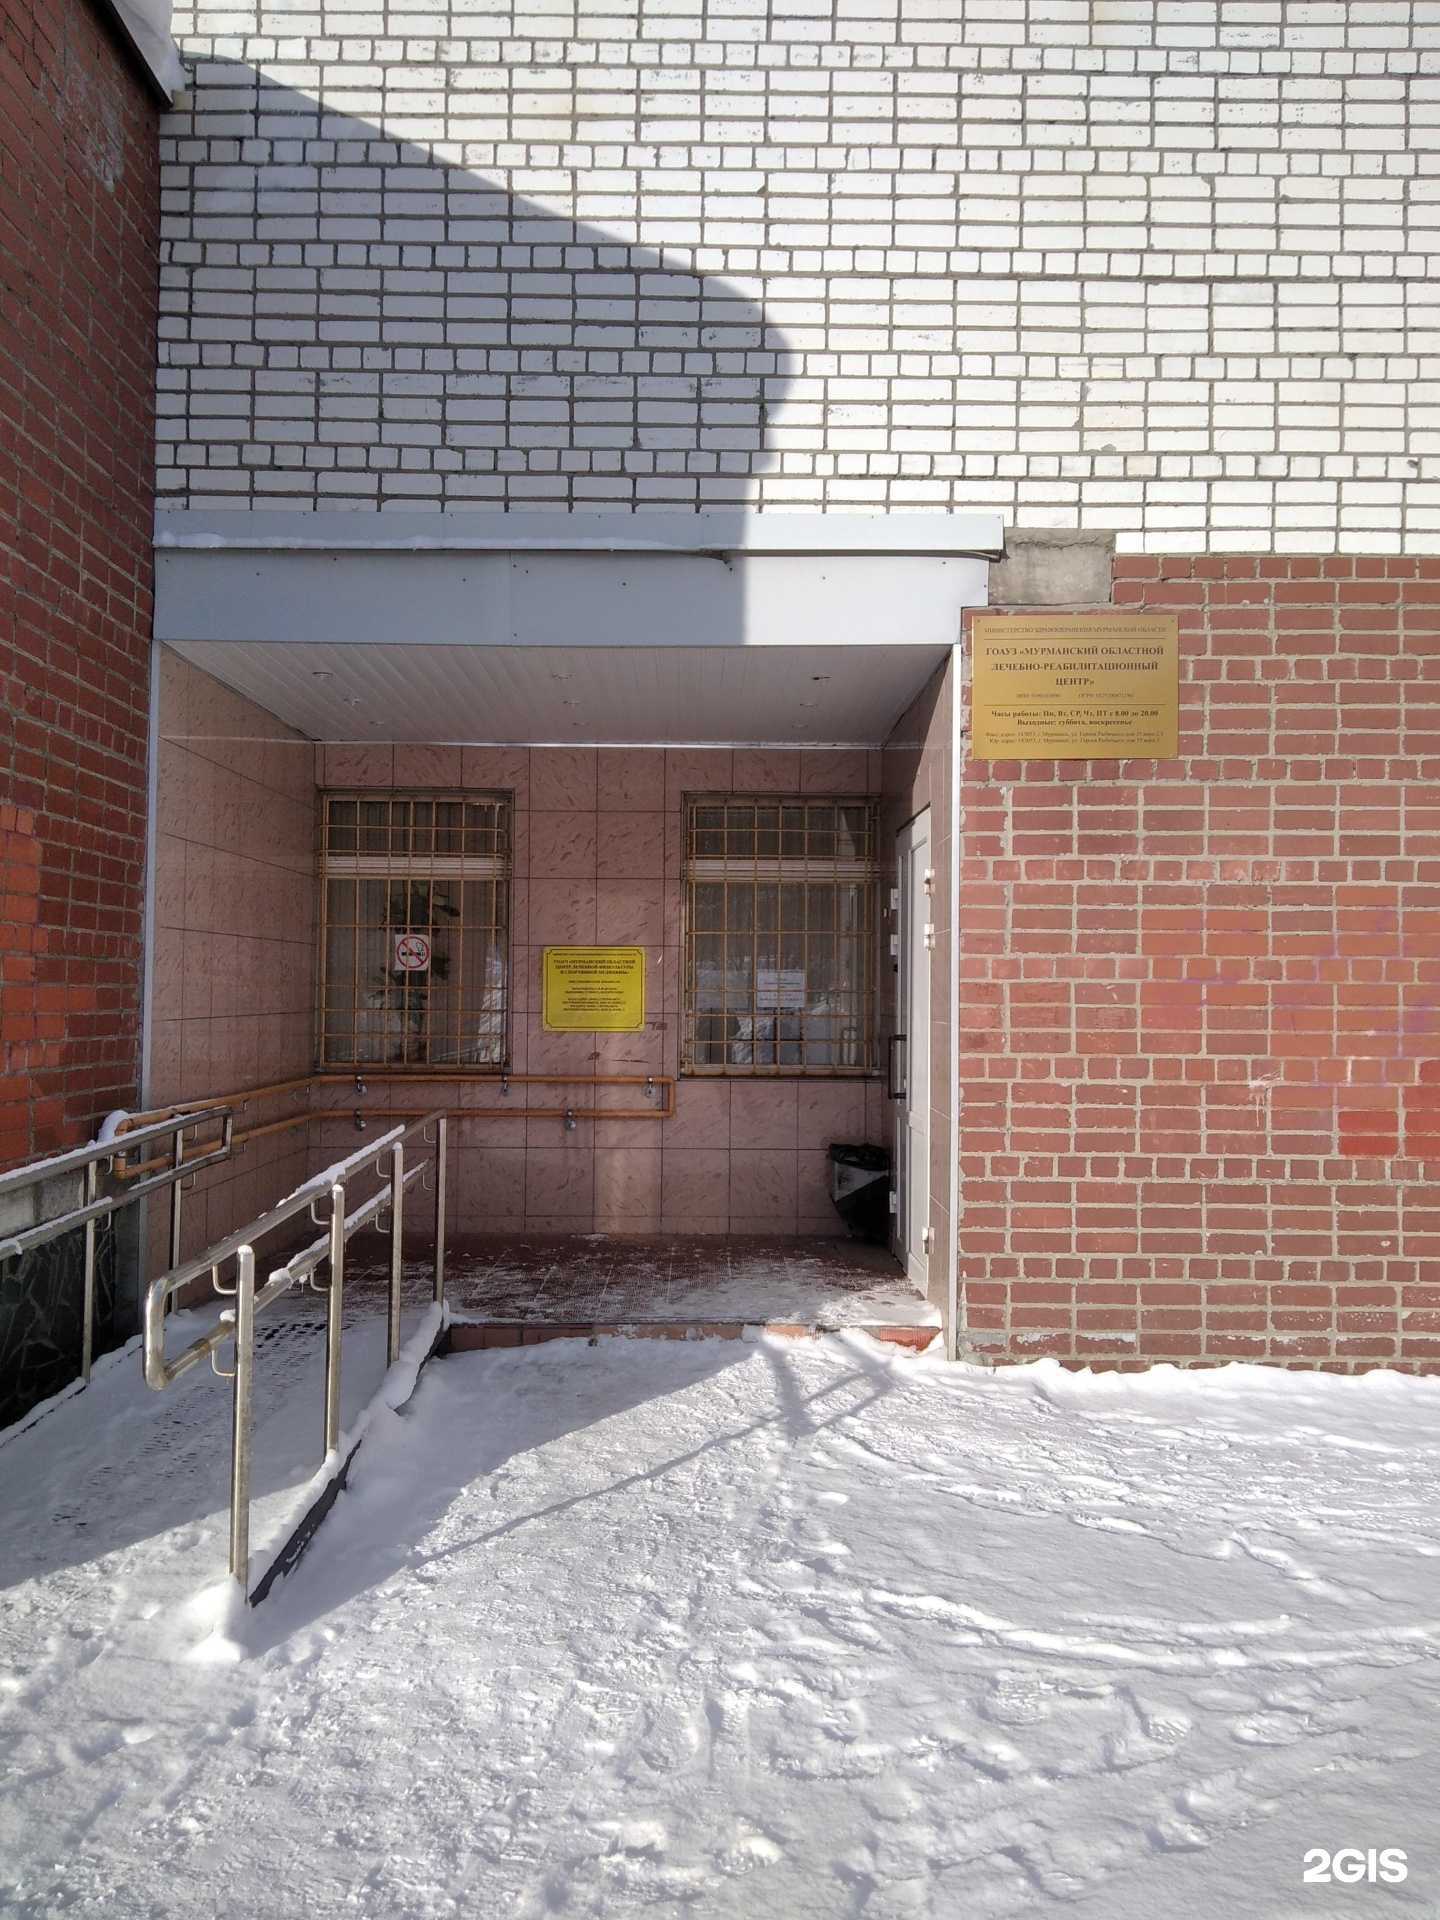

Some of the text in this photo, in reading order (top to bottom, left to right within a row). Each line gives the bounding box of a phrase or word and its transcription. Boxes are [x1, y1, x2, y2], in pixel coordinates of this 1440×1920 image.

[985, 645, 1164, 656] ГОАУЗ «МУРМАНСКИЙ ОБЛАСТНОЙ
[991, 661, 1159, 672] ЛЕЧЕБНО-РЕАБИЛИТАЦИОННЫЙ
[1055, 677, 1095, 687] ЦЕНТР»
